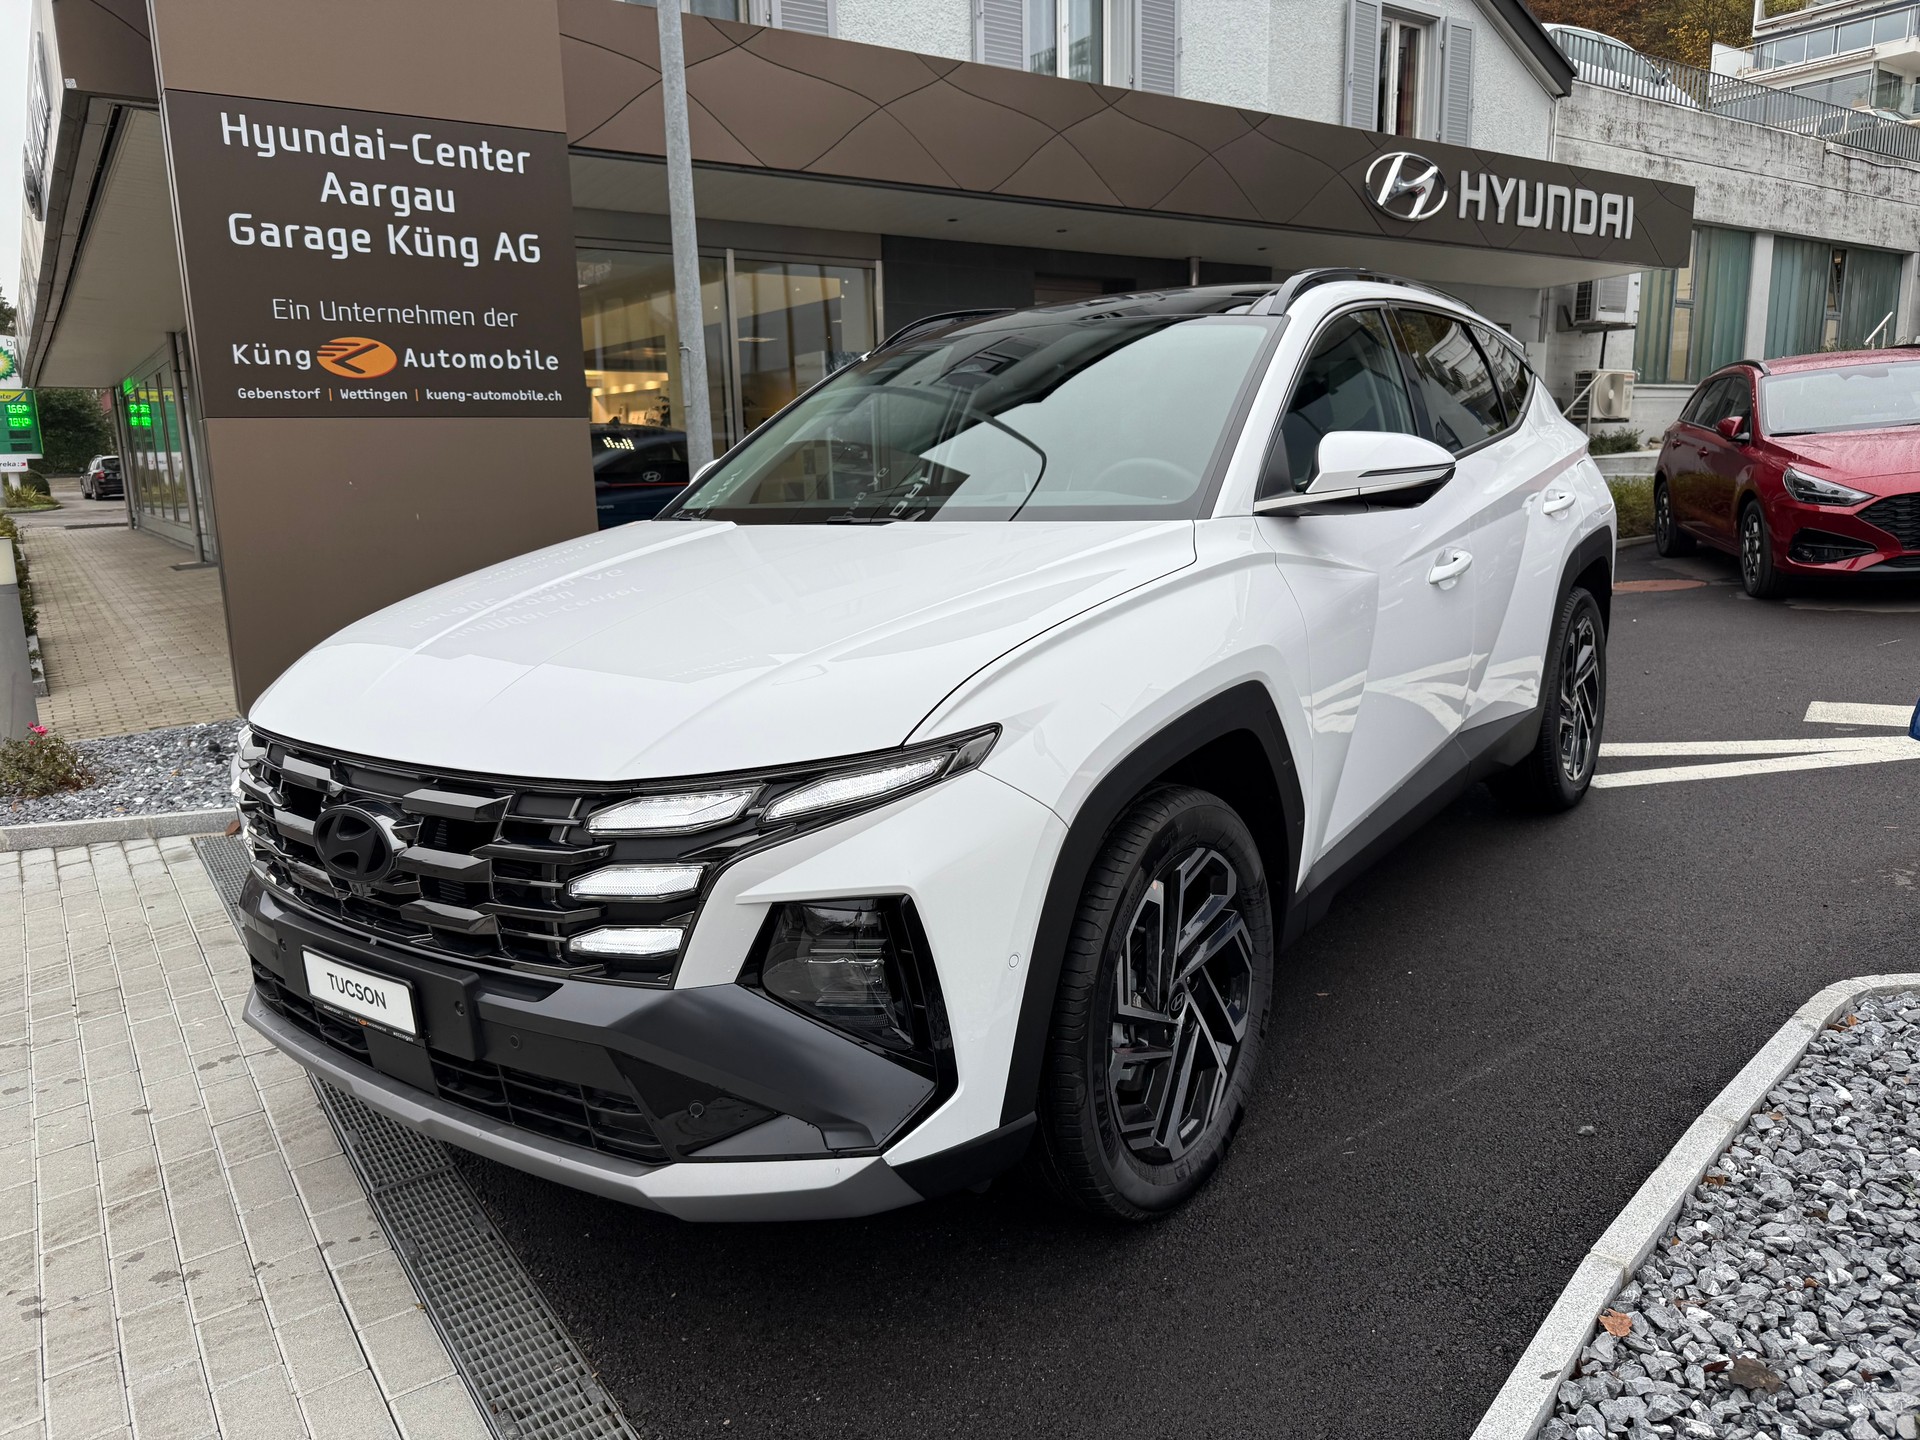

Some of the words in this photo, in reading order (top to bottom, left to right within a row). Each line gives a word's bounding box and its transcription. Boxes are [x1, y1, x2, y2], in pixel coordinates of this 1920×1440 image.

[220, 112, 531, 173] Hyundai-Center
[320, 171, 456, 217] Aargau
[1458, 170, 1634, 240] HYUNDAI
[228, 212, 372, 260] Garage
[387, 223, 480, 268] Küng
[494, 231, 541, 264] AG
[272, 298, 310, 321] Ein
[319, 300, 476, 327] Unternehmen
[483, 307, 519, 328] der
[232, 343, 312, 371] Küng
[403, 347, 559, 371] Automobile
[237, 387, 321, 400] Gebenstorf
[339, 388, 408, 402] Wettingen
[425, 388, 562, 402] kueng-automobile.ch
[326, 973, 387, 1009] TUCSON
